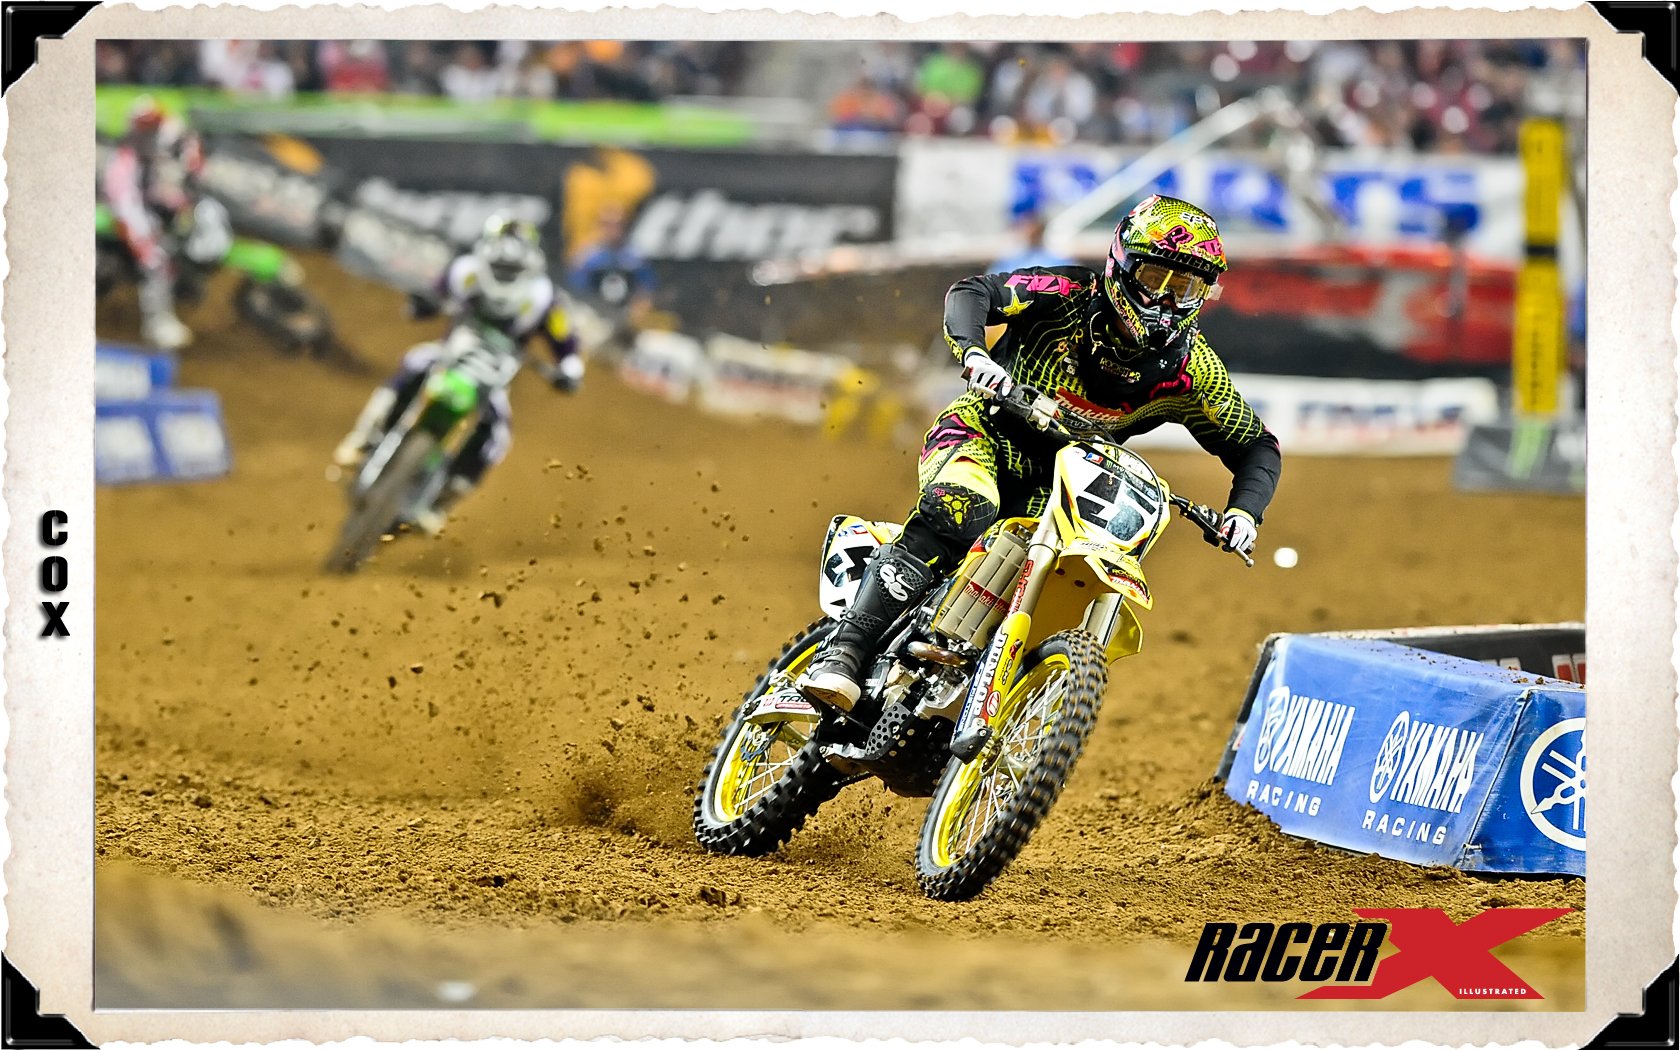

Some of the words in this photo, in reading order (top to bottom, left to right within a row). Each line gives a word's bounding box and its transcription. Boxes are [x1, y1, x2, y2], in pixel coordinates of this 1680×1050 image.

[972, 633, 1009, 717] DUNLOP
[1269, 695, 1355, 786] YAMAHA
[1390, 720, 1485, 814] YAMAHA
[1246, 780, 1322, 816] RACING
[1362, 810, 1447, 845] RACING
